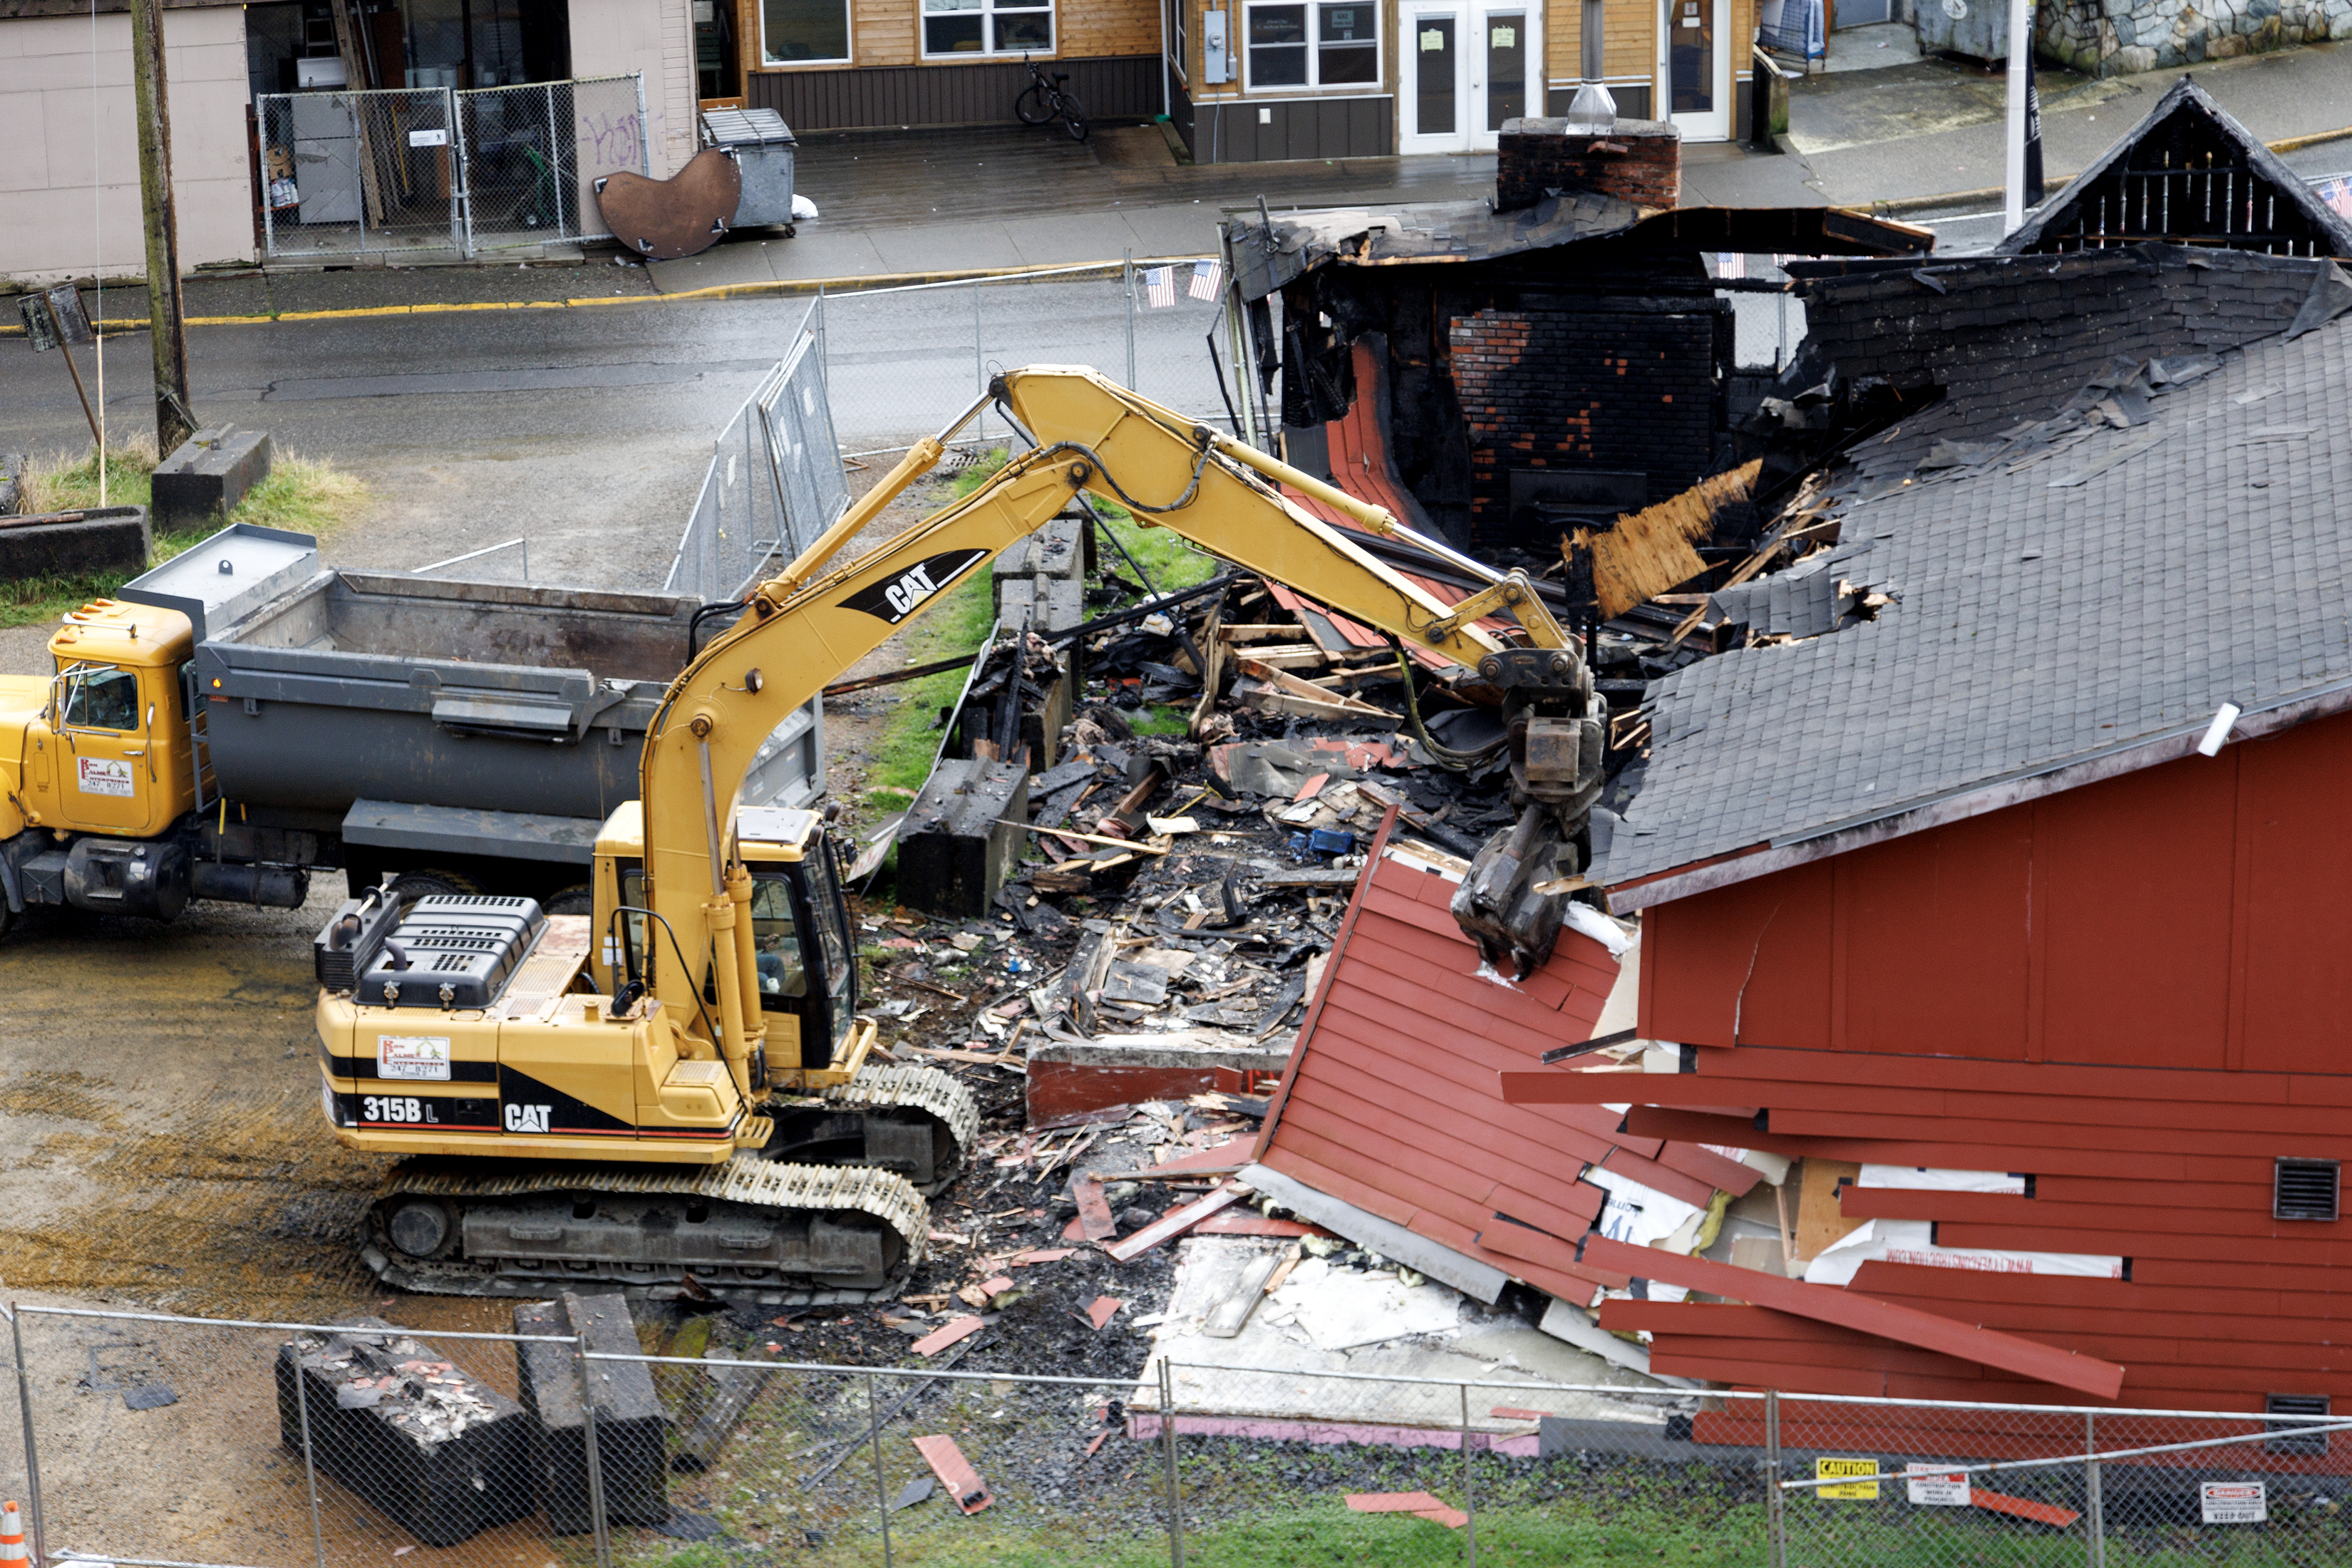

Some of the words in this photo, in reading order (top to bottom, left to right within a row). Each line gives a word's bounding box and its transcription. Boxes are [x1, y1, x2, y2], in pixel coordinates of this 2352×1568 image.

[885, 562, 938, 614] CAT
[363, 1096, 422, 1123] 315B
[425, 1103, 439, 1124] L
[505, 1103, 552, 1133] CAT
[1820, 1461, 1877, 1475] CAUTION
[2213, 1511, 2235, 1520] KEEP
[2237, 1511, 2254, 1520] OUT
